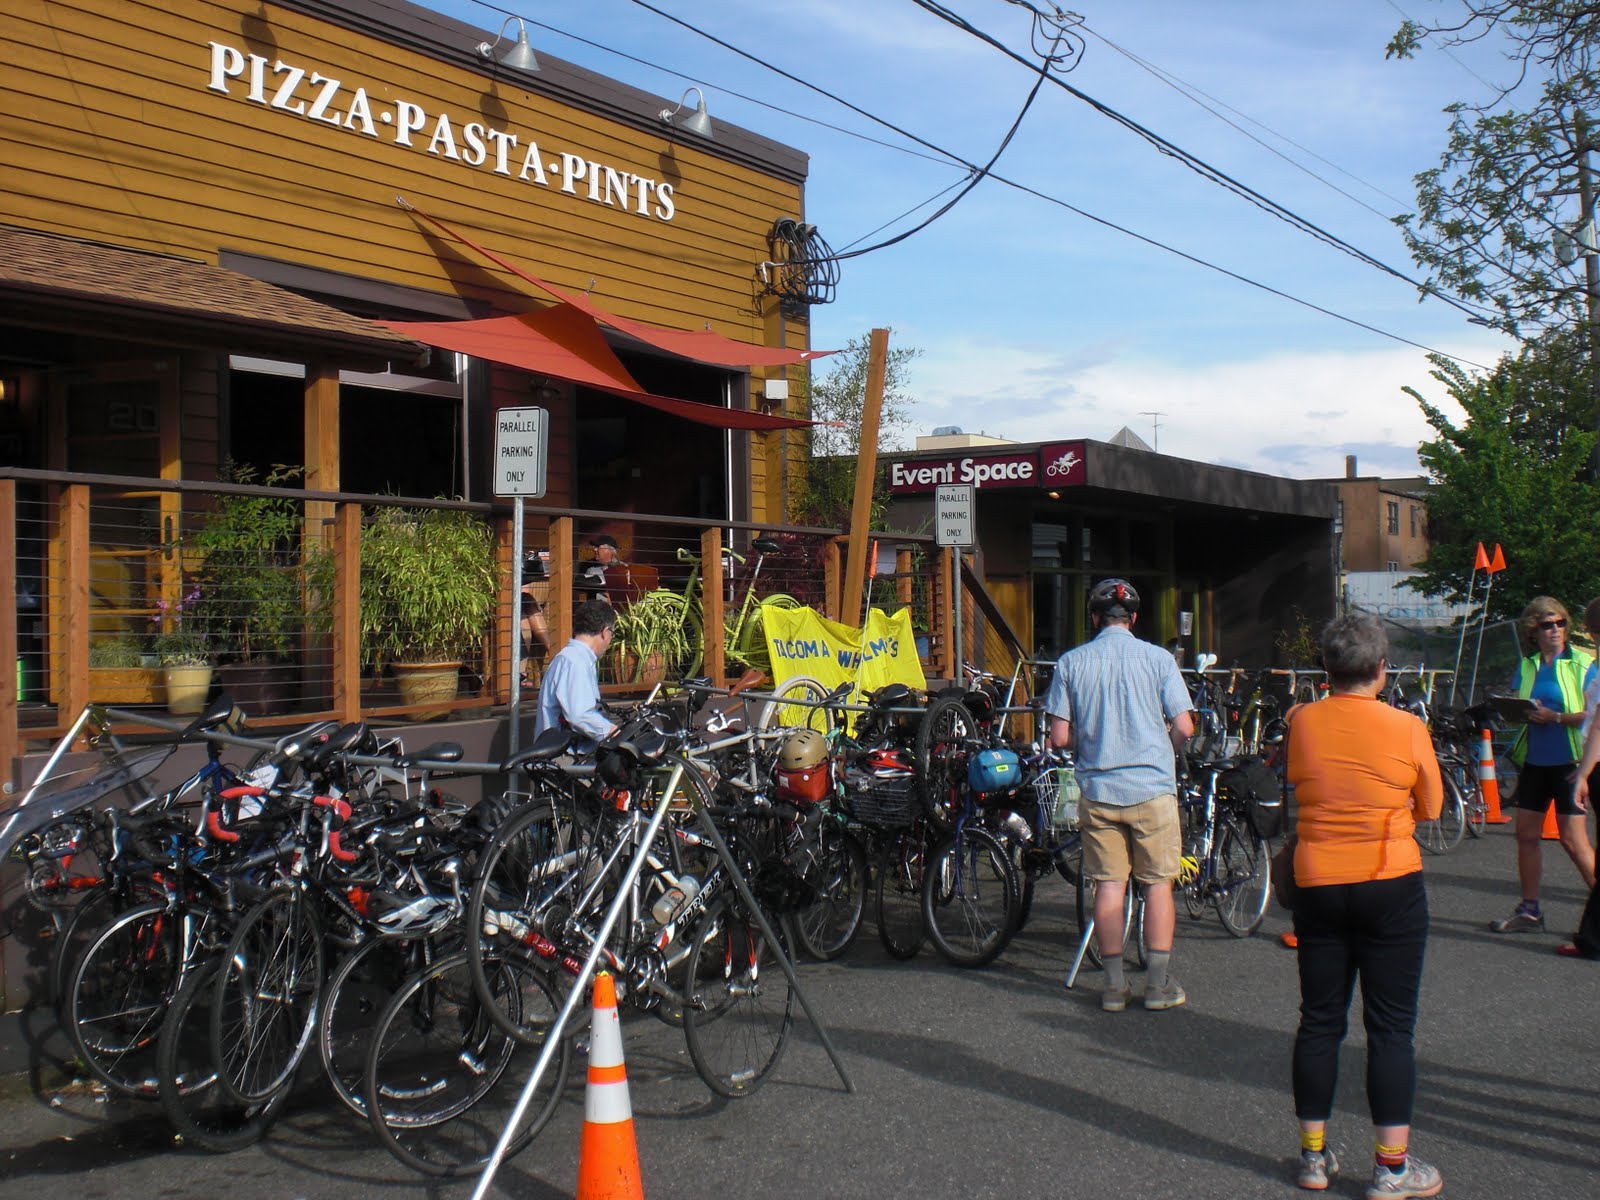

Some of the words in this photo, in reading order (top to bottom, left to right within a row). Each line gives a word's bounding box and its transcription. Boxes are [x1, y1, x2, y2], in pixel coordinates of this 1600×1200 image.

[207, 41, 378, 138] PIZZA
[394, 99, 549, 186] PASTA
[559, 152, 675, 222] PINTS
[500, 421, 536, 433] PARALLEL
[501, 446, 533, 457] PARKING
[506, 471, 525, 482] ONLY
[892, 462, 955, 486] Event
[960, 458, 1033, 487] Space
[939, 494, 969, 503] PARALLEL
[941, 511, 967, 520] PARKING
[946, 528, 961, 537] ONLY
[773, 638, 830, 659] TACOMA
